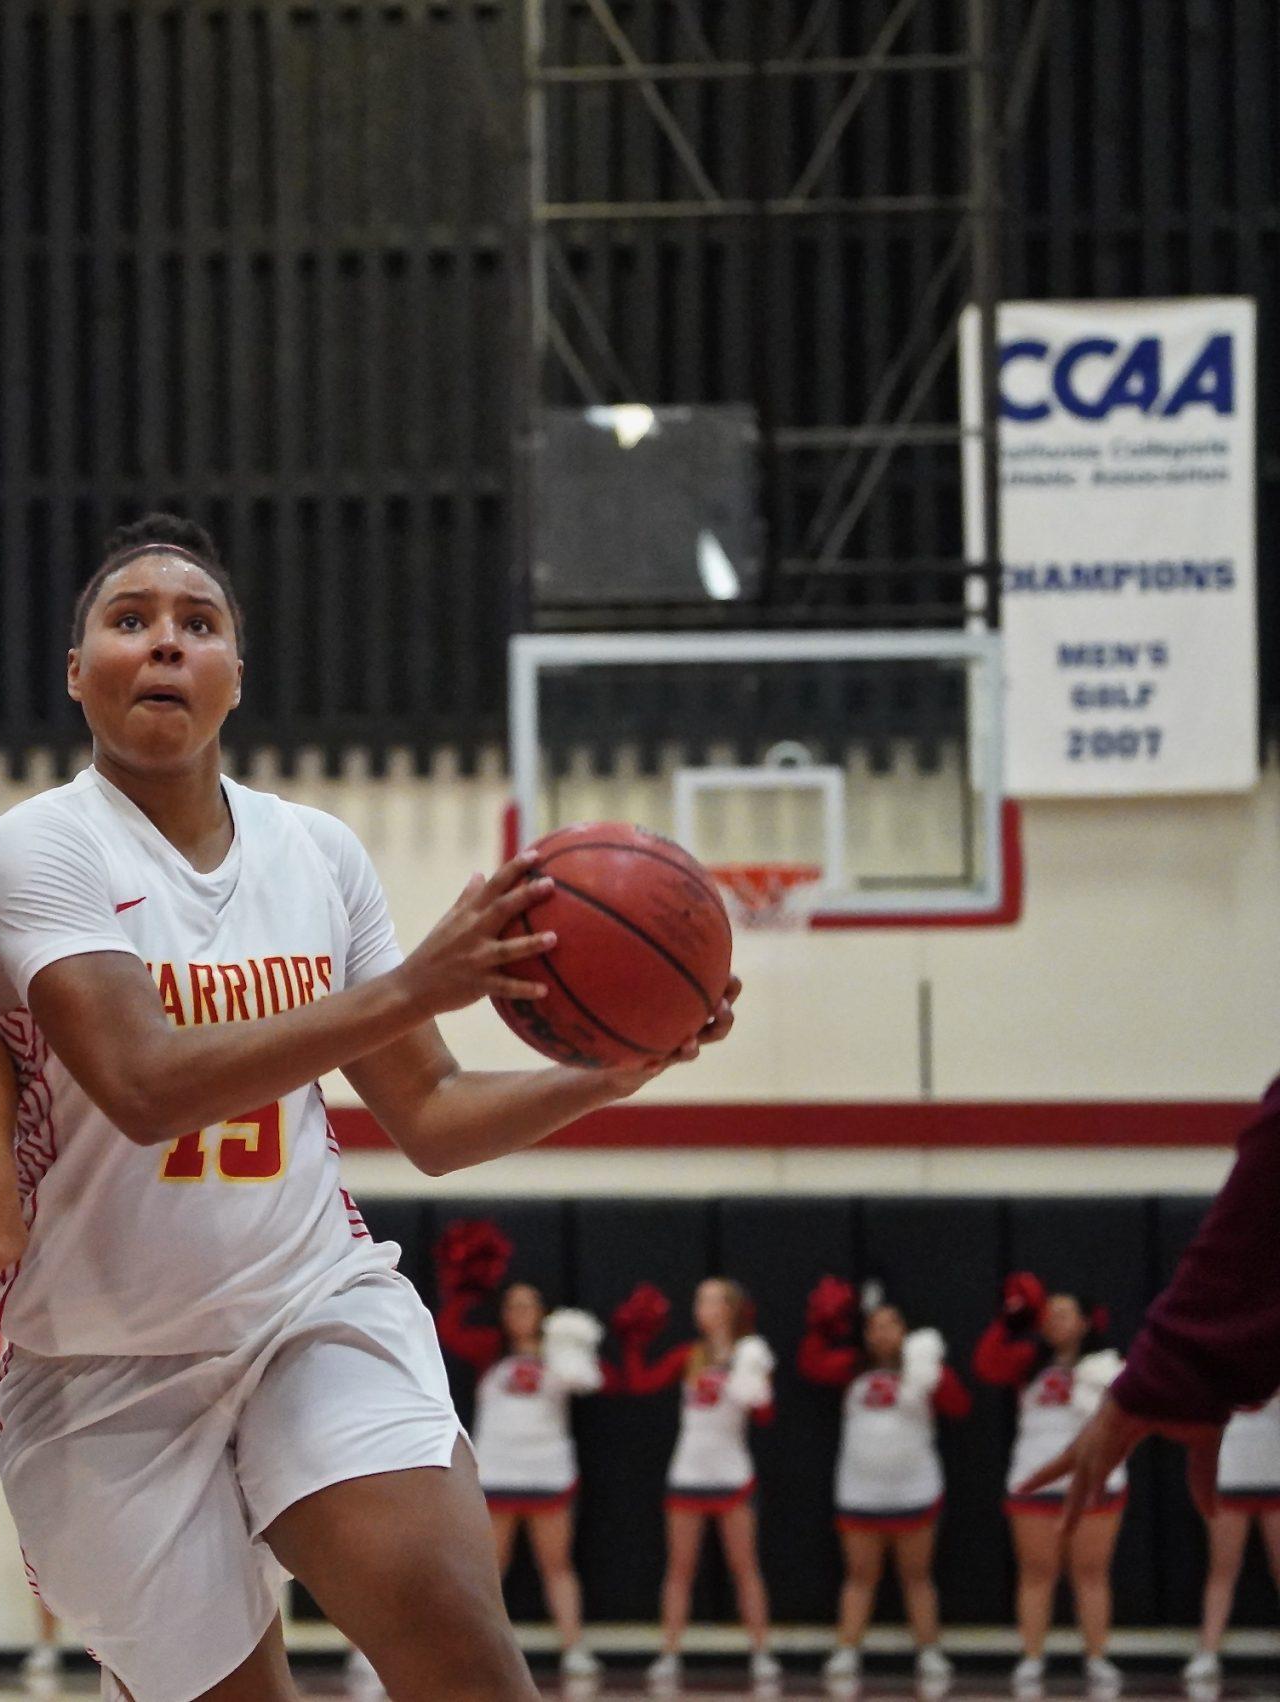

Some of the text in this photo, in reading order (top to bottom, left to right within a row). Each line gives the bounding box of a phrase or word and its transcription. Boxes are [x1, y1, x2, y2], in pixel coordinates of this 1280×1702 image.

[997, 333, 1236, 422] CCAA
[1057, 643, 1168, 669] MEN'S
[1066, 726, 1162, 761] 2007
[147, 955, 332, 1027] ARRIORS
